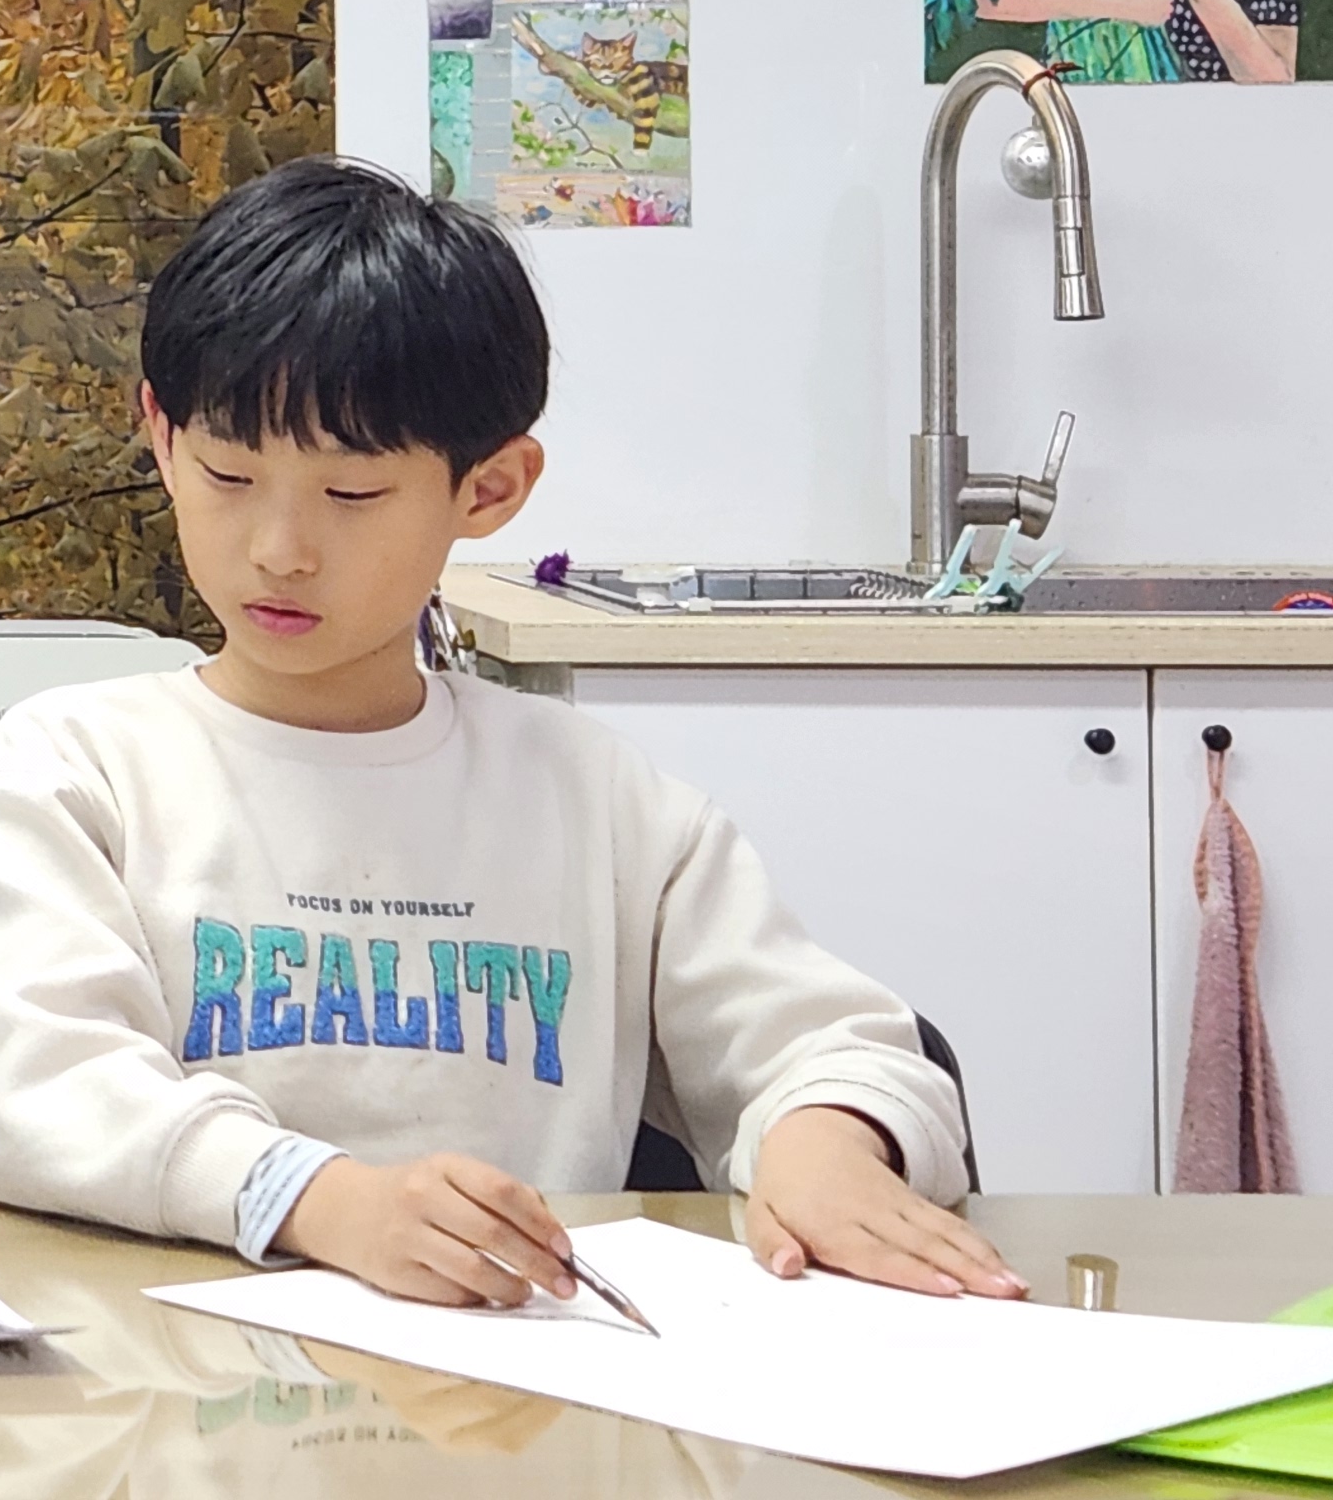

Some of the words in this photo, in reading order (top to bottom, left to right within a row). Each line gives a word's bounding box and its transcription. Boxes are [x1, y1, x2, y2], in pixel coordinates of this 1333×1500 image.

[287, 893, 343, 914] FOCUS
[350, 899, 374, 915] ON
[380, 900, 475, 918] YOURSELF
[183, 916, 573, 1087] REALITY
